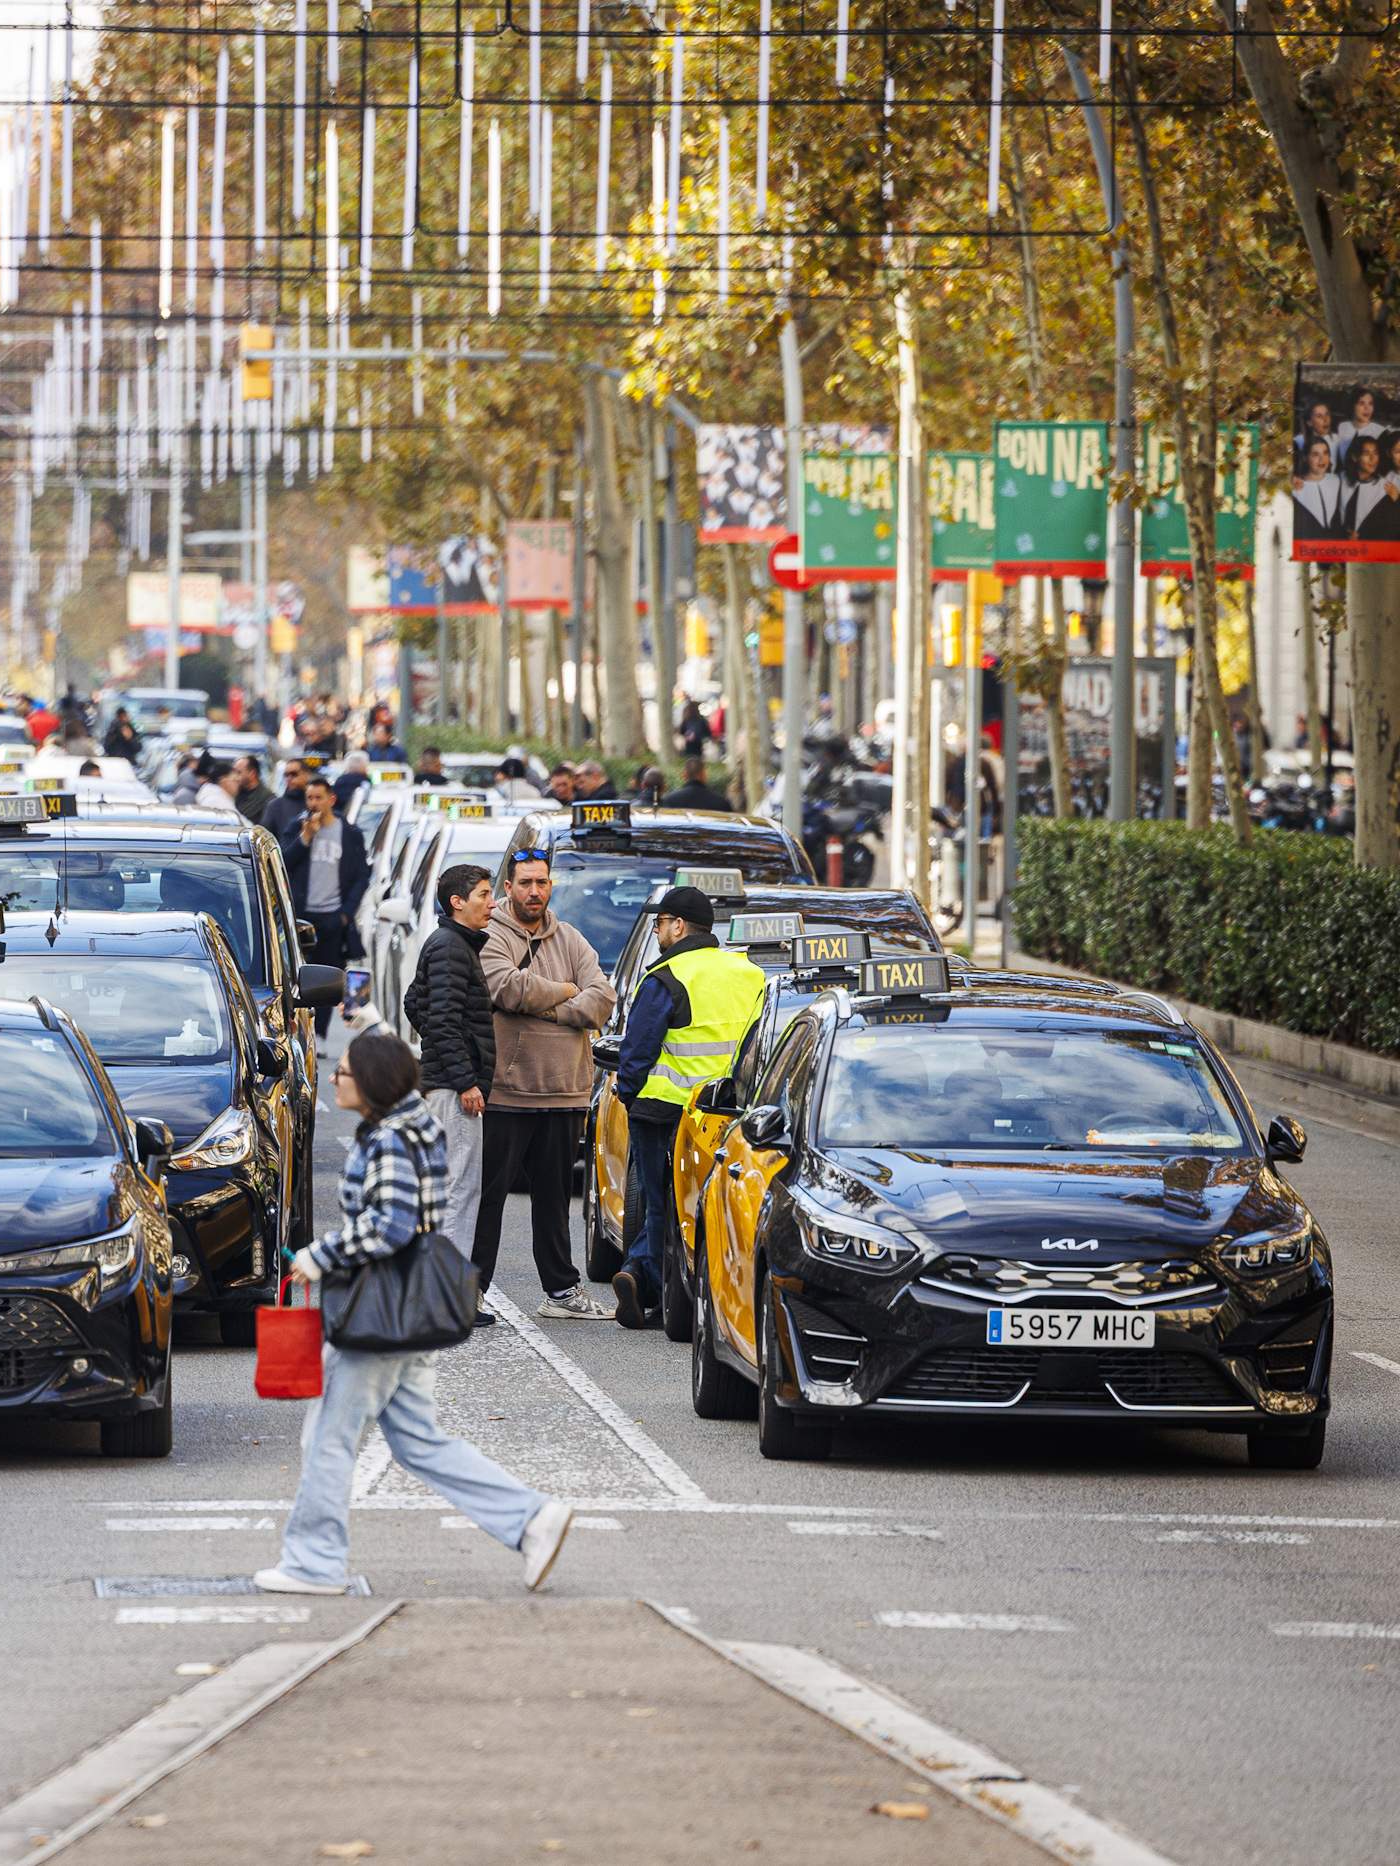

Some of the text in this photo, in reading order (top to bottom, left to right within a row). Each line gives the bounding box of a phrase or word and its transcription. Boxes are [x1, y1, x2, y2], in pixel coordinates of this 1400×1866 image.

[998, 428, 1104, 490] BON NA
[1147, 430, 1252, 518] DL!
[584, 806, 614, 823] TAXI
[691, 875, 720, 890] TAXI
[746, 919, 780, 938] TAXI
[805, 938, 847, 960] TAXI
[877, 962, 924, 988] TAXI
[1010, 1315, 1082, 1340] 5957
[1093, 1315, 1145, 1341] MHC
